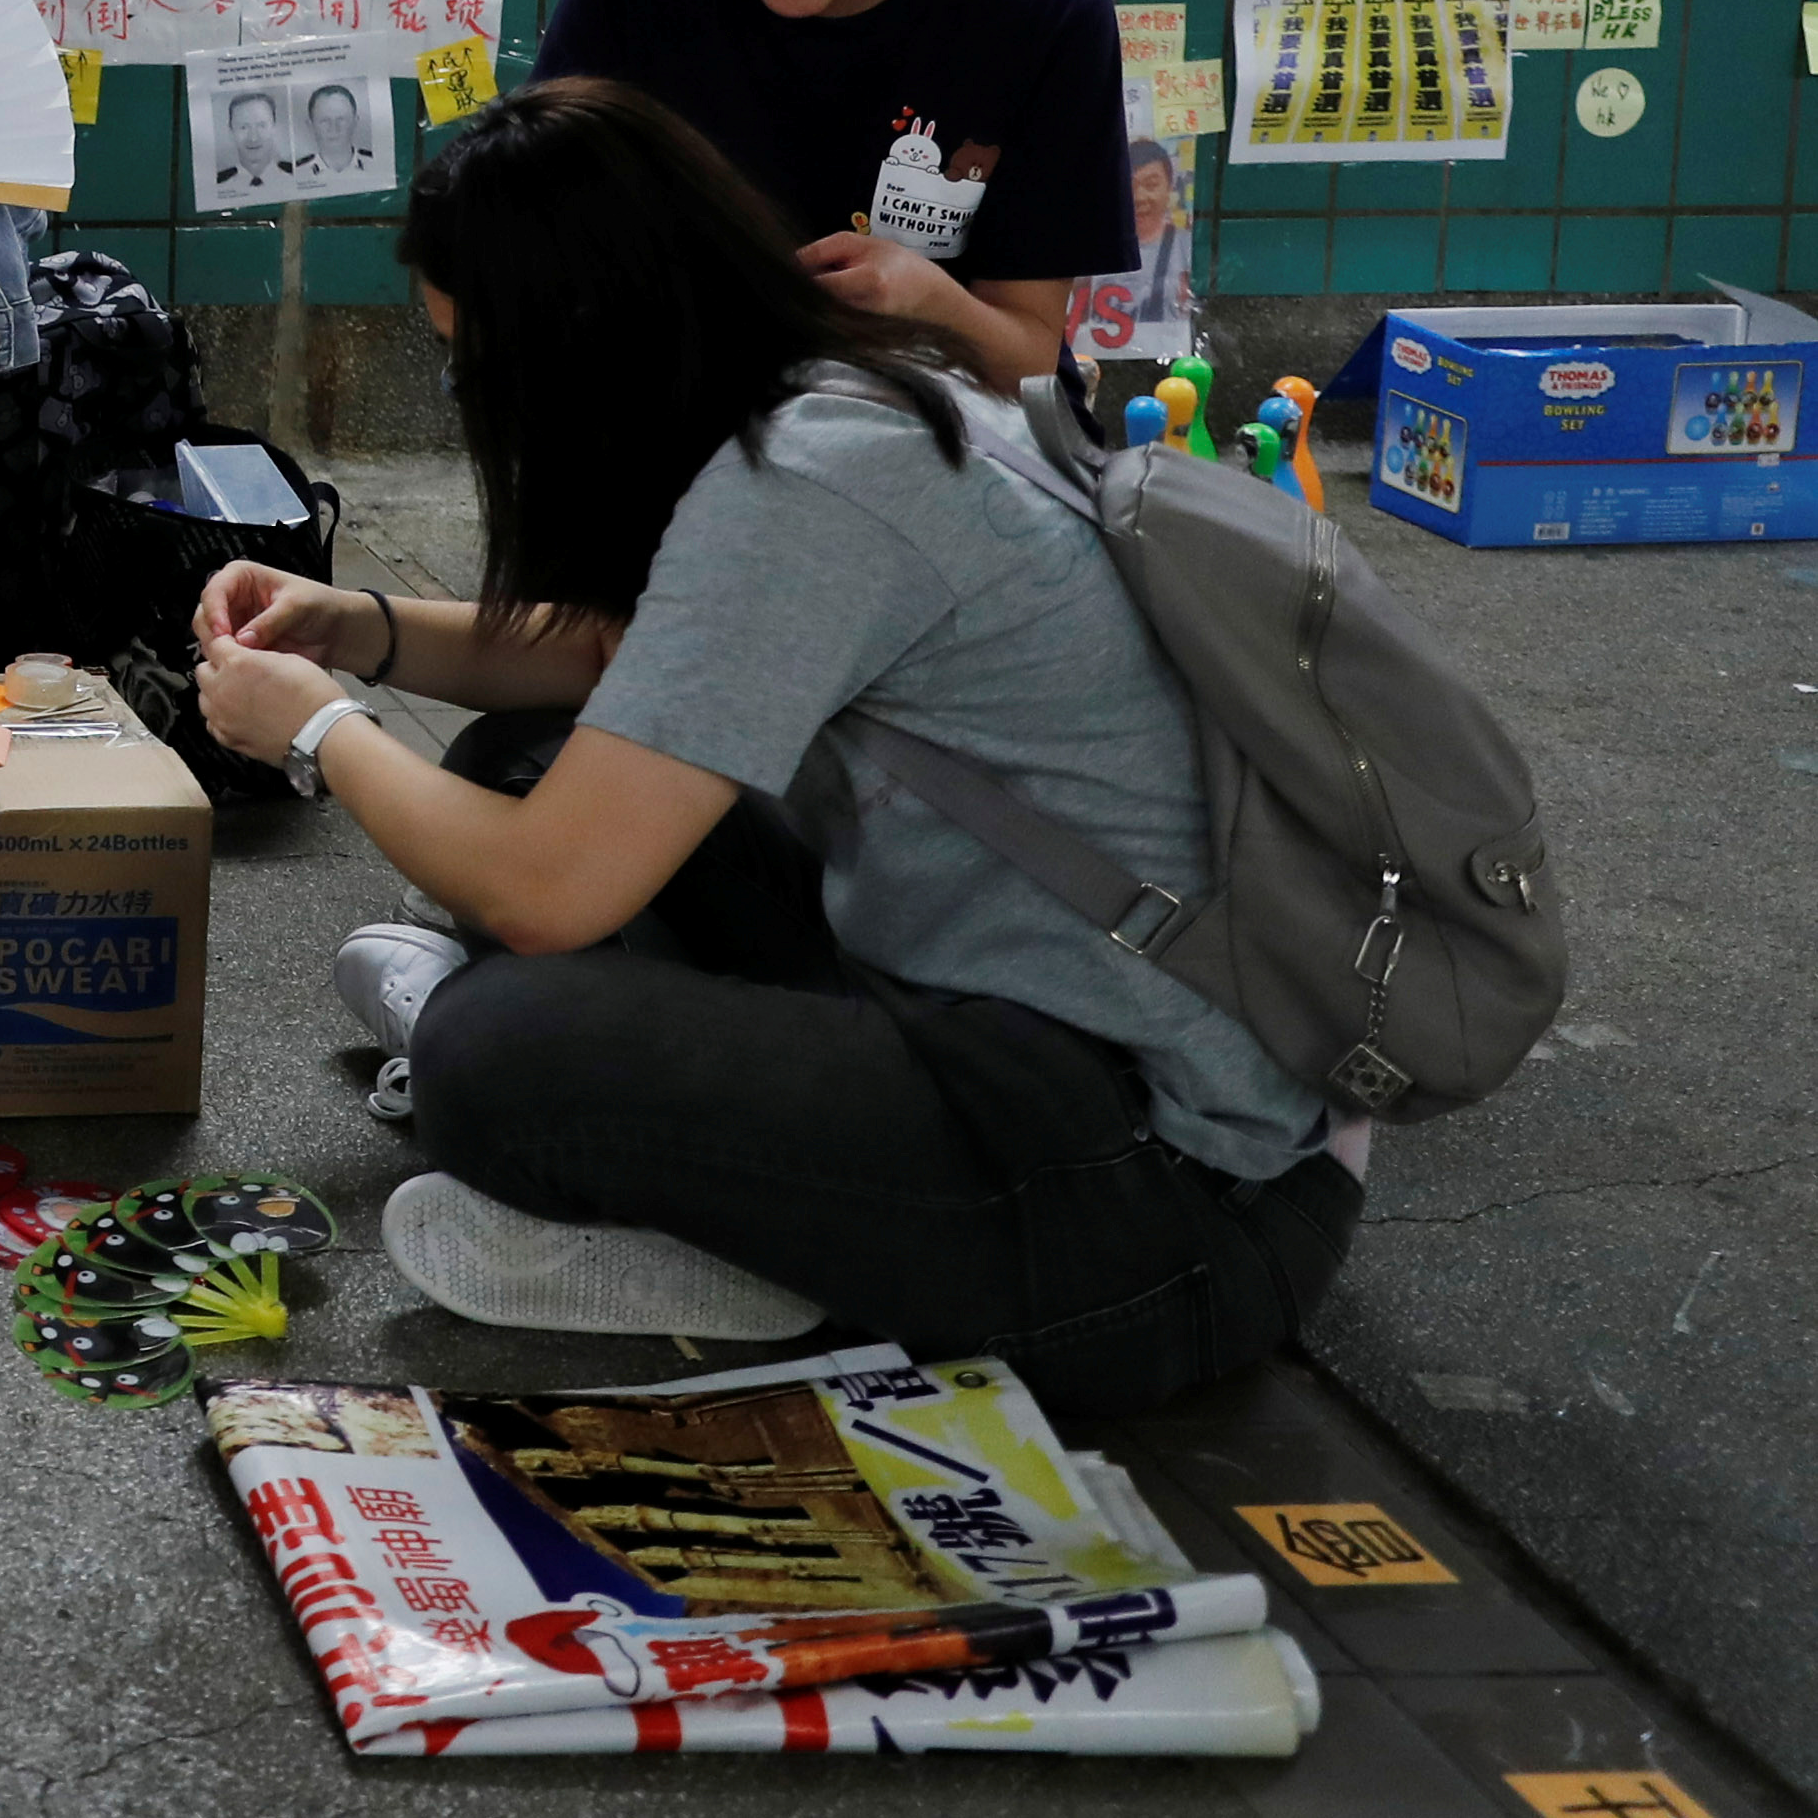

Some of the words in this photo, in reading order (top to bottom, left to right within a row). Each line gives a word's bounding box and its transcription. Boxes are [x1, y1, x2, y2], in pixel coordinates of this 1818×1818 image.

[1590, 4, 1654, 23] BLESS
[1601, 22, 1639, 40] HK
[1548, 368, 1608, 383] THOMAS
[1543, 404, 1607, 419] BOWLING
[1560, 418, 1587, 432] SET
